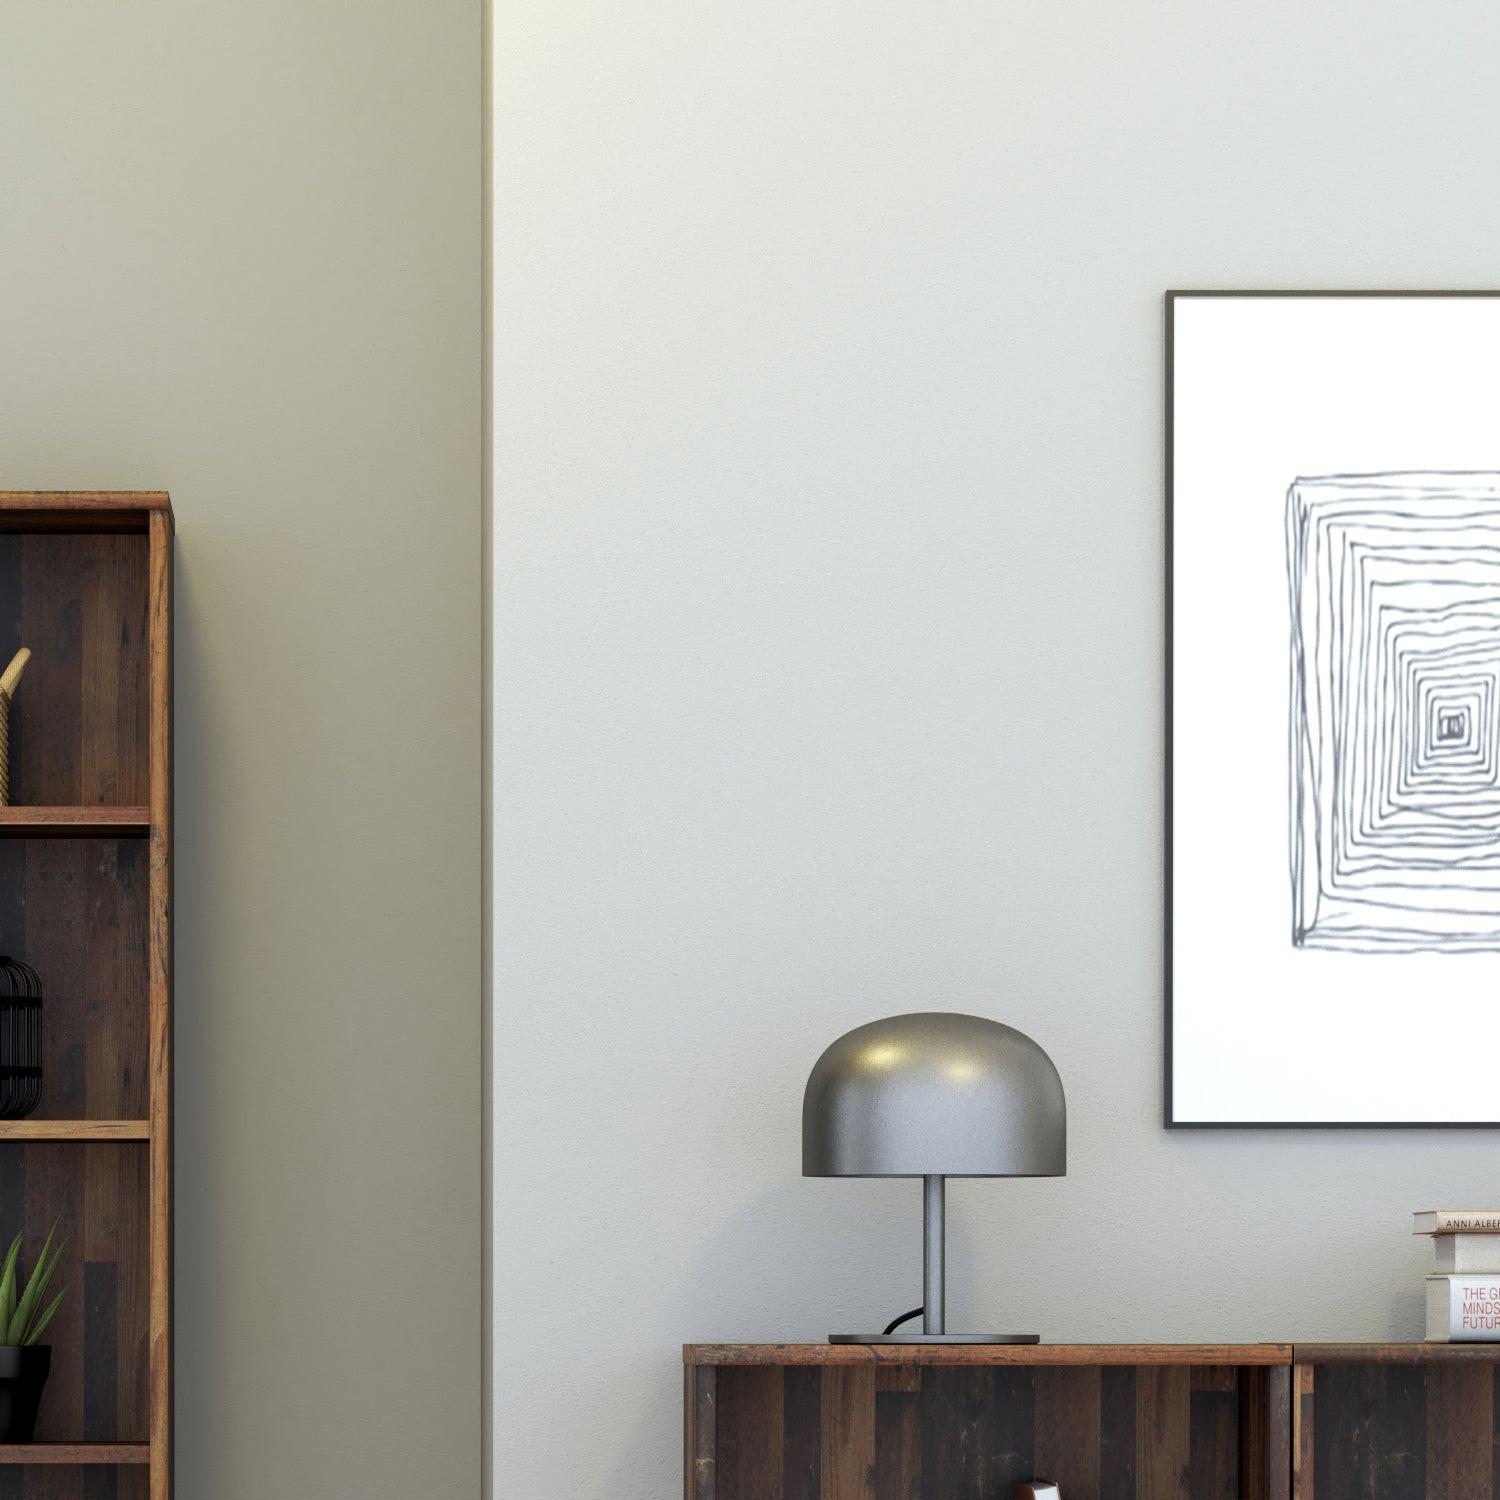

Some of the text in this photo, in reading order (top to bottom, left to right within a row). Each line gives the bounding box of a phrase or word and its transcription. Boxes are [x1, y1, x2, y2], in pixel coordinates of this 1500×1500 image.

[1446, 1219, 1471, 1228] ANNI
[1463, 1288, 1487, 1300] THE
[1463, 1302, 1500, 1314] MINDS
